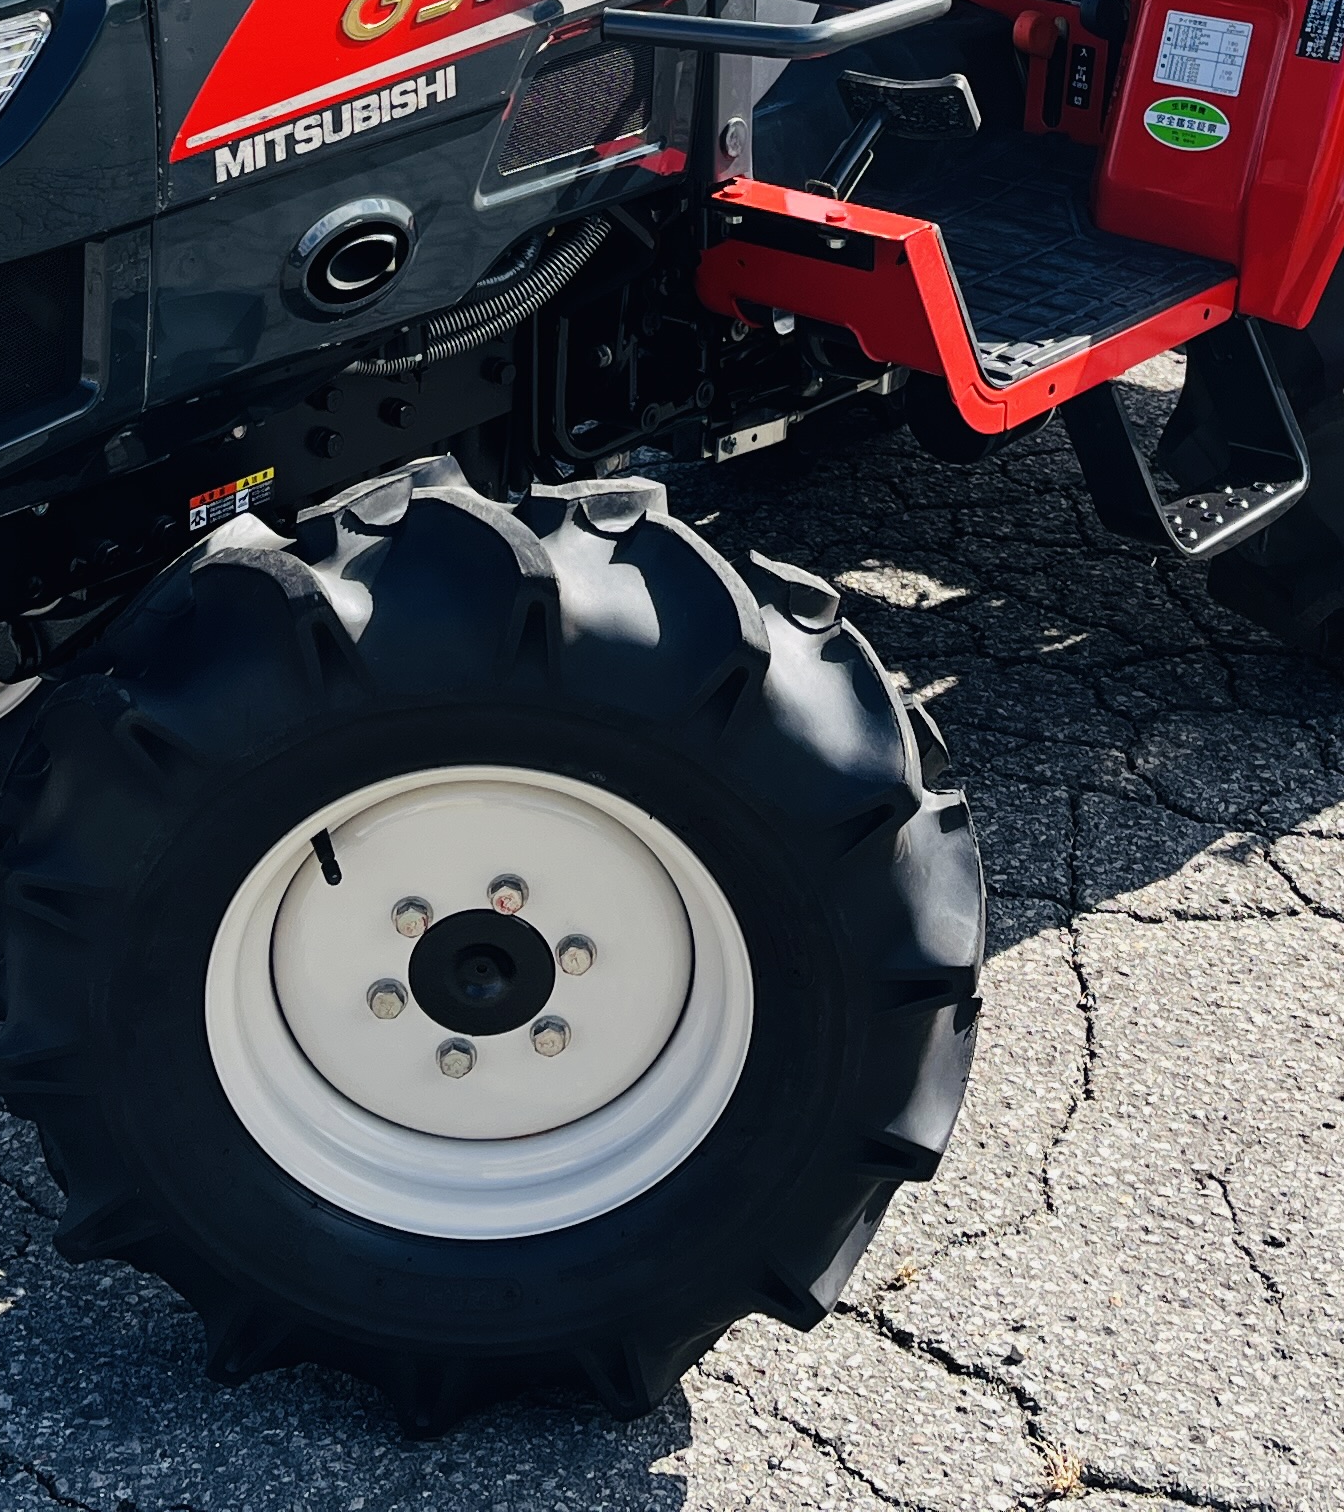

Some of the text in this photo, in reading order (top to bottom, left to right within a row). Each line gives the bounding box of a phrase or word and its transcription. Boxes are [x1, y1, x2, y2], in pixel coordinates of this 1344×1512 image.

[1079, 48, 1088, 57] 入
[1072, 80, 1089, 90] 4WD
[214, 64, 458, 183] MITSUBISHI
[1155, 113, 1218, 134] 安全鑑定証票
